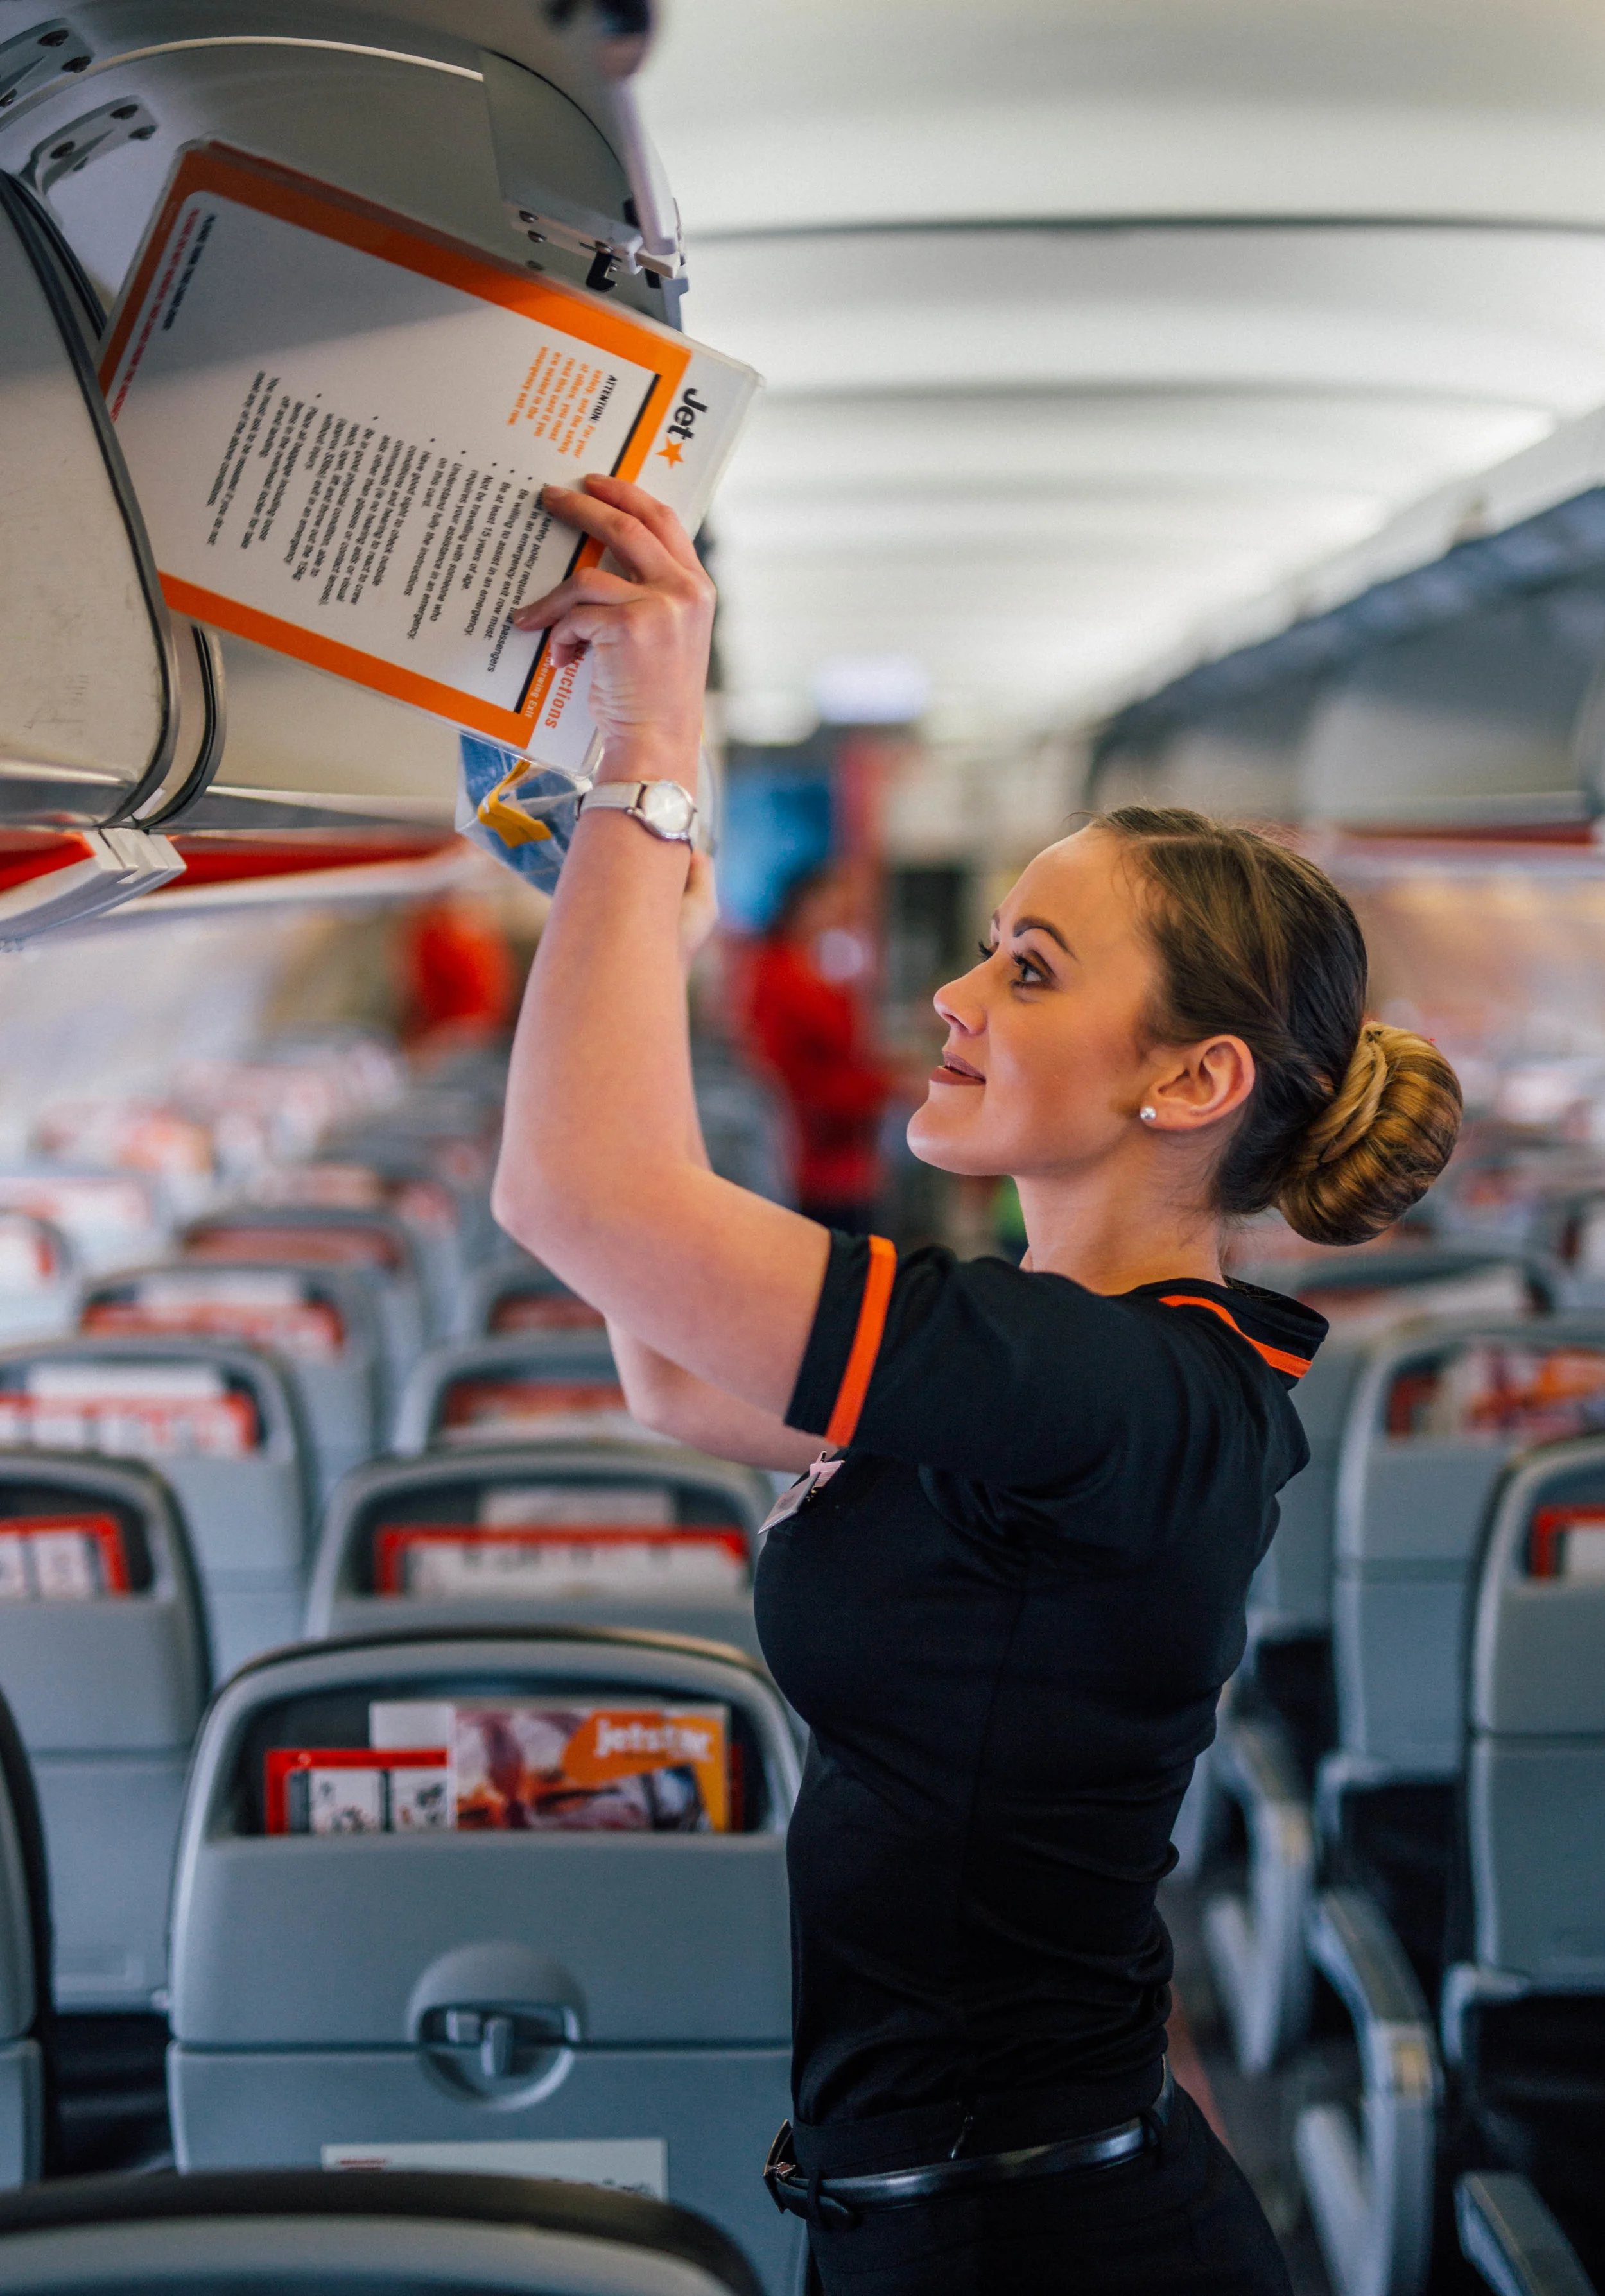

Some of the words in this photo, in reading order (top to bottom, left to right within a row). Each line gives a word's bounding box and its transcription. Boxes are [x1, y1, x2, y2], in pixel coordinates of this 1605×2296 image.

[562, 358, 574, 376] read
[577, 398, 588, 413] and
[591, 375, 616, 420] ATTENTION:
[559, 403, 569, 418] you
[668, 388, 706, 438] Jet
[534, 422, 546, 436] you
[571, 415, 582, 427] the
[574, 439, 586, 457] your
[395, 445, 416, 487] conditions
[417, 451, 431, 471] Have
[437, 457, 447, 469] on
[407, 472, 420, 495] good
[431, 470, 443, 485] this
[437, 463, 461, 510] Understand
[459, 470, 478, 503] requires
[480, 475, 493, 490] Not
[499, 481, 511, 492] Be
[387, 490, 398, 506] and
[422, 487, 435, 506] card.
[475, 491, 486, 502] be
[495, 494, 503, 503] at
[517, 488, 528, 499] Be
[398, 496, 411, 517] sight
[451, 505, 463, 524] your
[487, 505, 501, 524] least
[504, 502, 521, 528] willing
[356, 514, 374, 544] hearing
[374, 508, 393, 539] hearing
[394, 518, 404, 528] to
[428, 512, 442, 529] fully
[458, 504, 480, 541] travelling
[525, 521, 534, 531] an
[535, 517, 553, 542] safety
[344, 530, 352, 540] or
[385, 529, 398, 553] check
[422, 531, 434, 545] the
[482, 527, 492, 537] 15
[501, 530, 511, 539] to
[371, 540, 381, 549] to
[434, 526, 455, 569] assistance
[453, 544, 464, 562] with
[473, 539, 485, 561] years
[491, 540, 505, 565] assist
[362, 552, 374, 572] react
[506, 533, 528, 578] emergency
[525, 543, 540, 568] policy
[346, 565, 354, 575] or
[372, 555, 388, 586] outside
[404, 547, 428, 595] instructions
[430, 571, 439, 579] in
[469, 563, 477, 573] of
[487, 567, 497, 575] in
[358, 573, 368, 582] to
[426, 580, 435, 592] an
[437, 564, 456, 601] someone
[462, 573, 473, 589] age.
[483, 576, 492, 587] an
[351, 584, 363, 605] crew
[500, 580, 510, 596] exit
[512, 571, 530, 604] requires
[429, 603, 442, 621] who
[464, 589, 487, 635] emergency.
[494, 598, 505, 614] row
[407, 593, 429, 639] emergency.
[484, 616, 498, 639] must:
[487, 624, 510, 671] passengers
[524, 699, 537, 718] Exit
